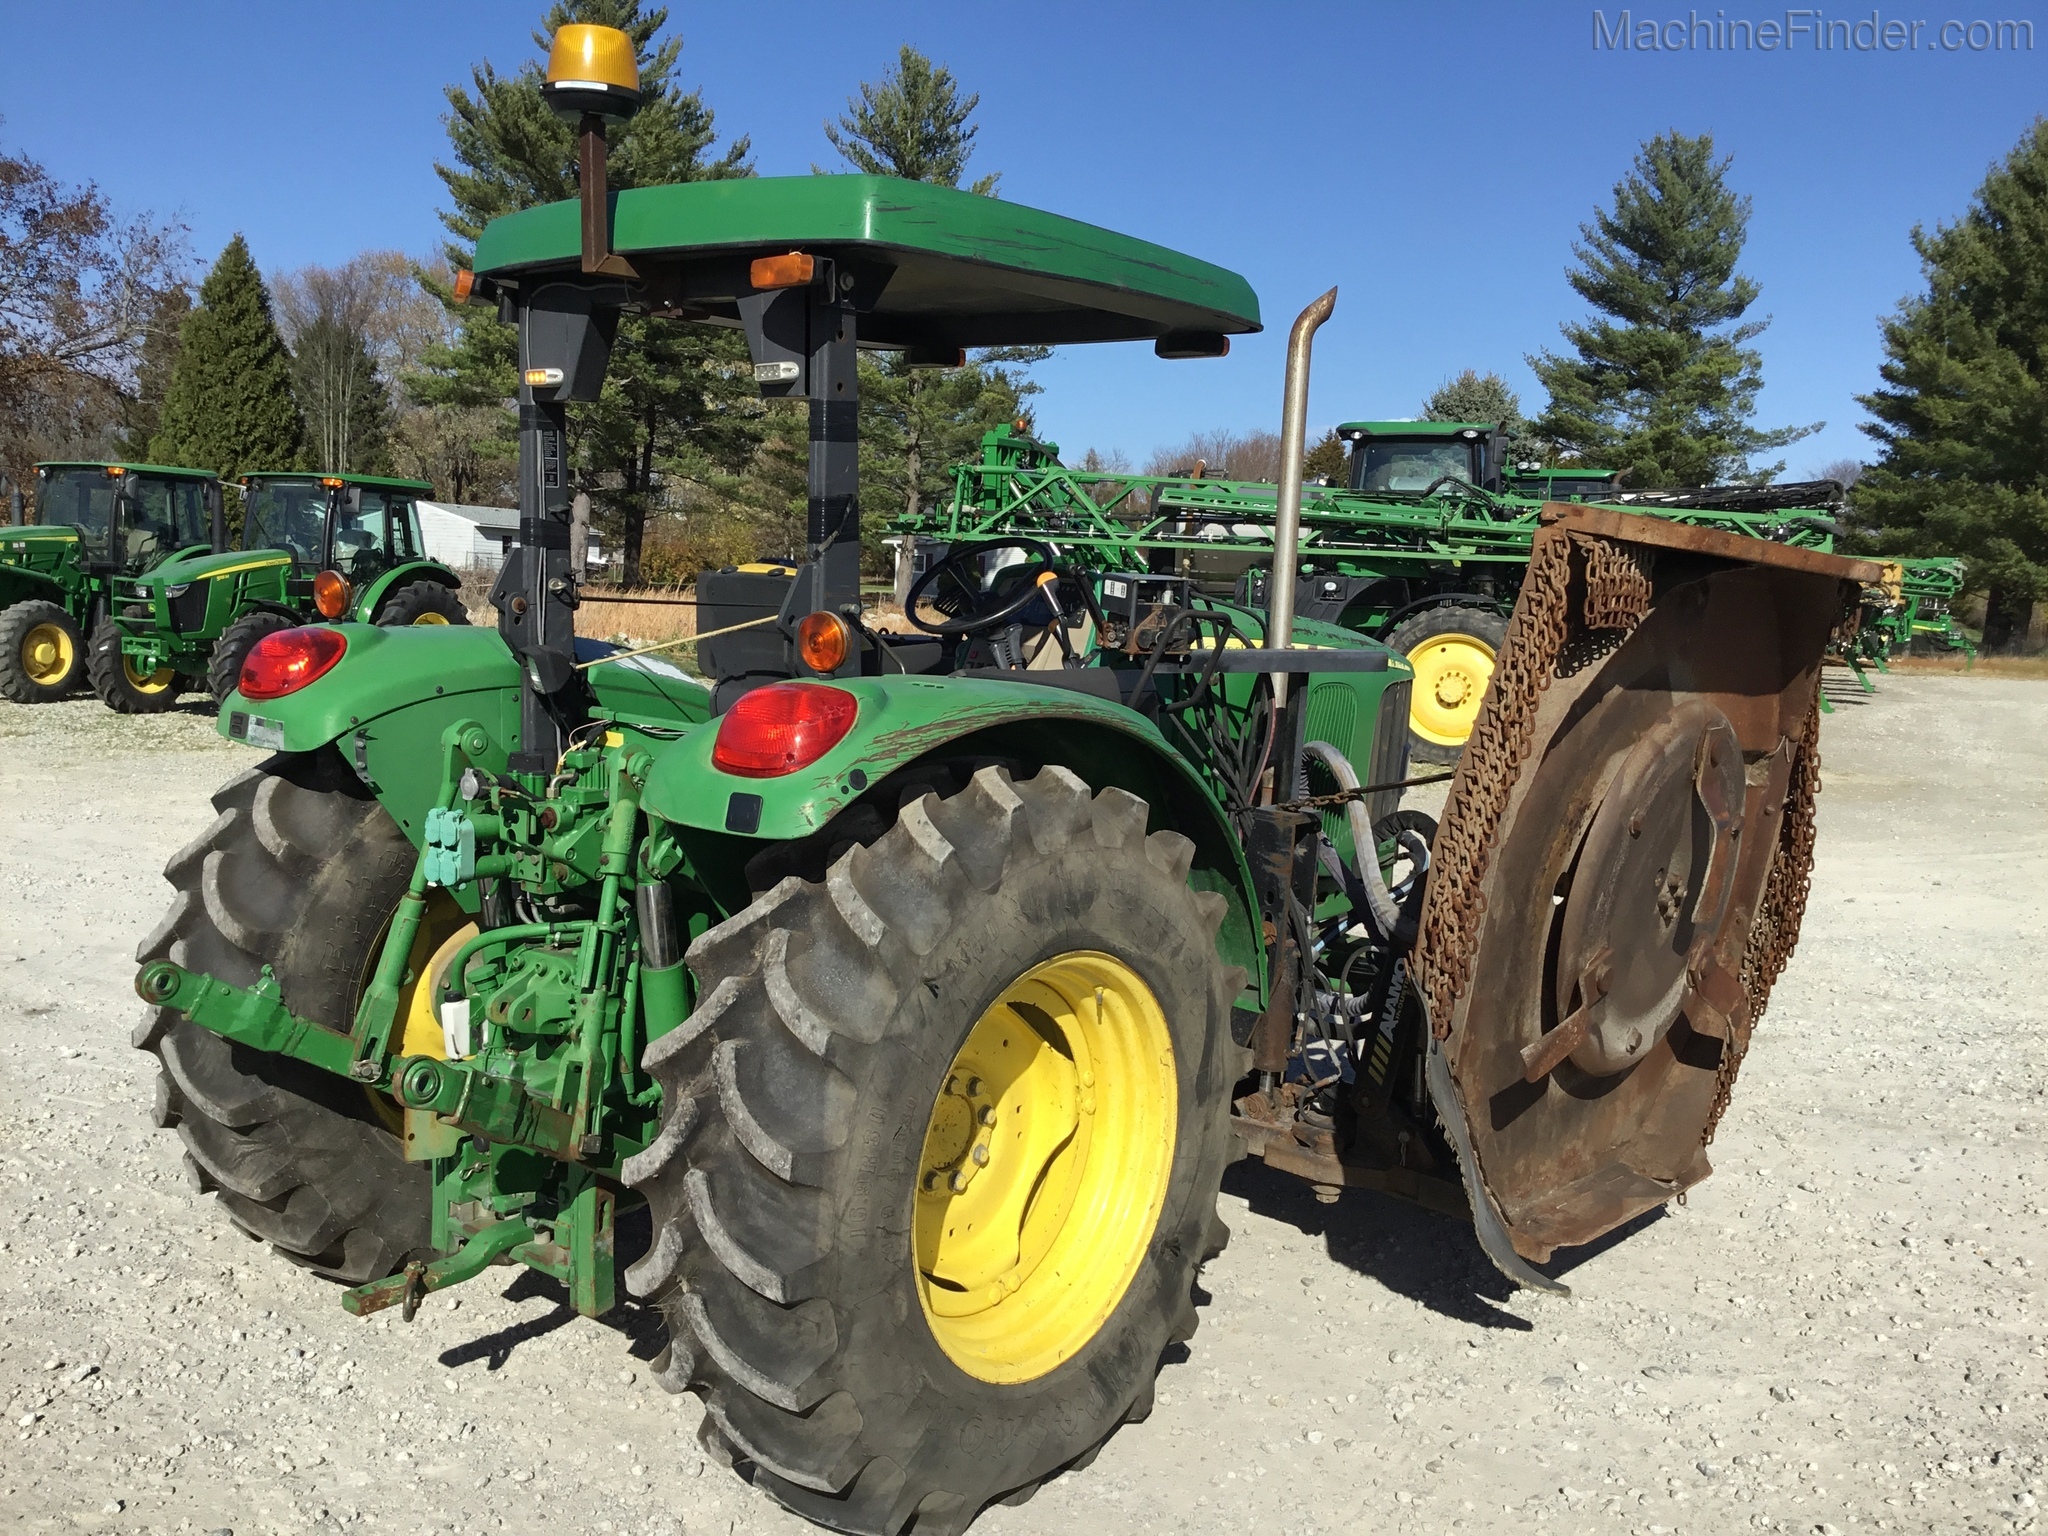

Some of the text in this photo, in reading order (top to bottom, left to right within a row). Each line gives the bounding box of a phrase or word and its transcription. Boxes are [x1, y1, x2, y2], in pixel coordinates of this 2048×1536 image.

[1379, 957, 1406, 1043] ALAMO
[1395, 973, 1411, 1021] INDUST
[849, 1106, 887, 1238] 16.9R30
